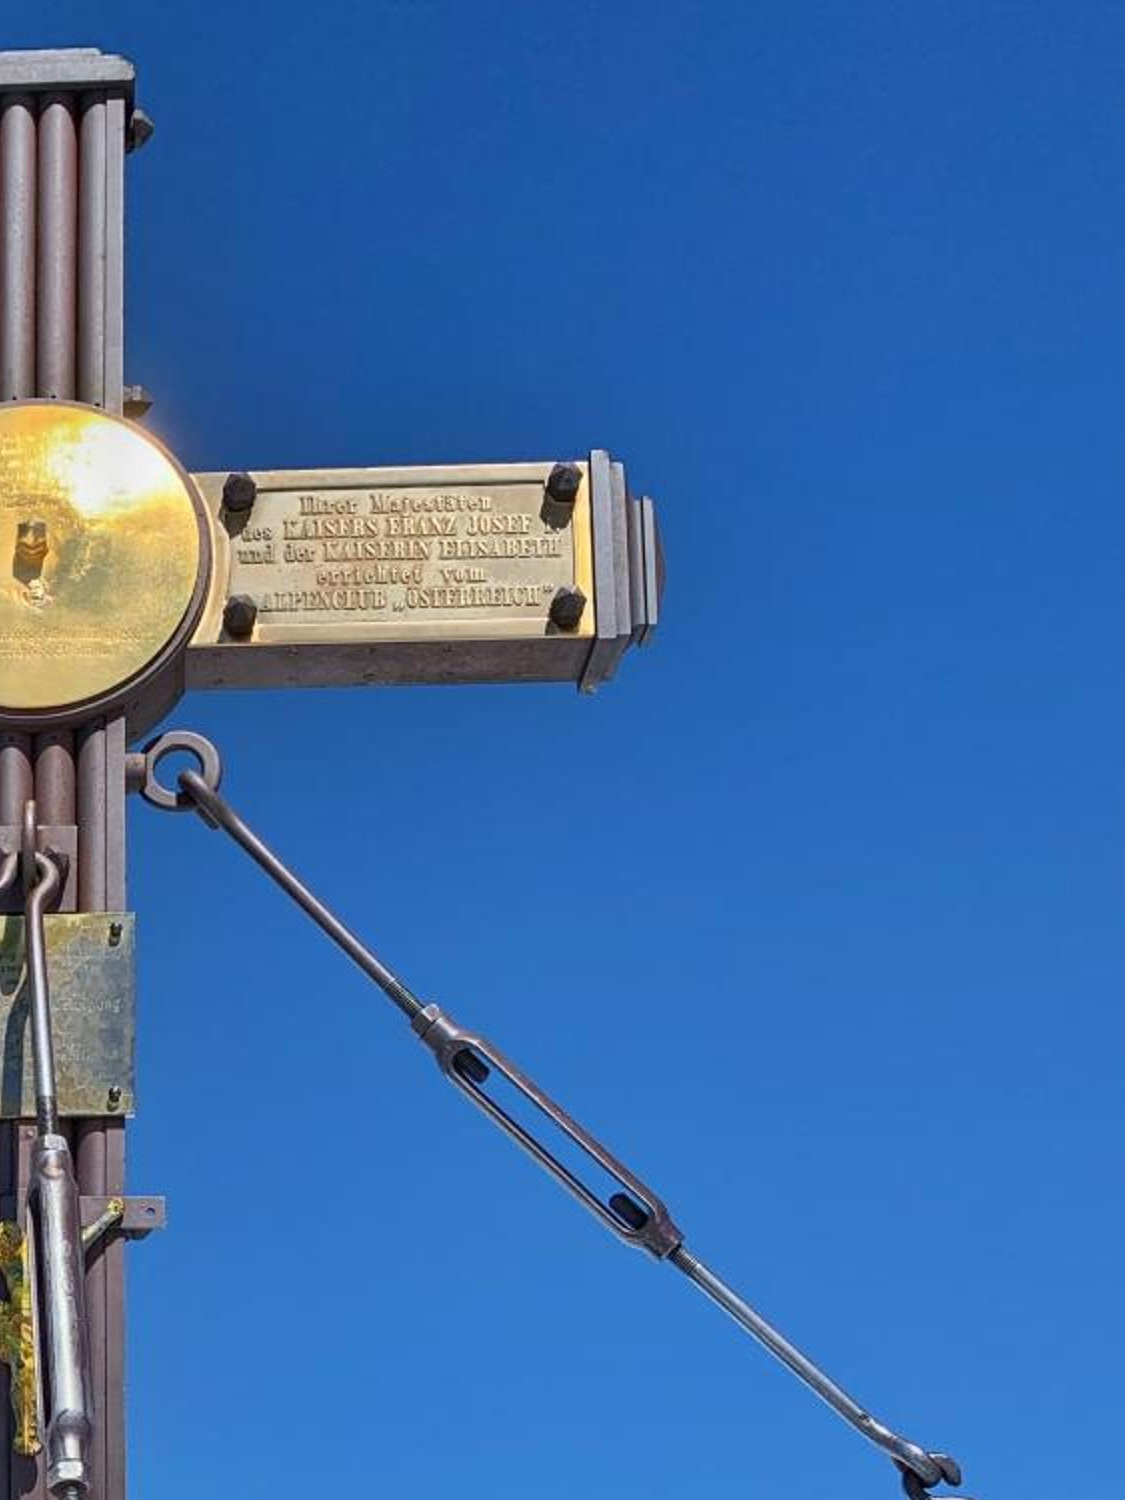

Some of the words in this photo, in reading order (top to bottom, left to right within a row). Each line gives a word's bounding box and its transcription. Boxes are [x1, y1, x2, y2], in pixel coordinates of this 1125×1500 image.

[283, 518, 378, 541] KAISERS
[385, 515, 458, 537] FRANZ
[466, 514, 532, 536] JOSEF
[323, 538, 432, 562] KAISERIN
[438, 537, 562, 560] ELISABETH
[316, 562, 424, 586] errichtet
[259, 587, 388, 612] ALPENCLUB
